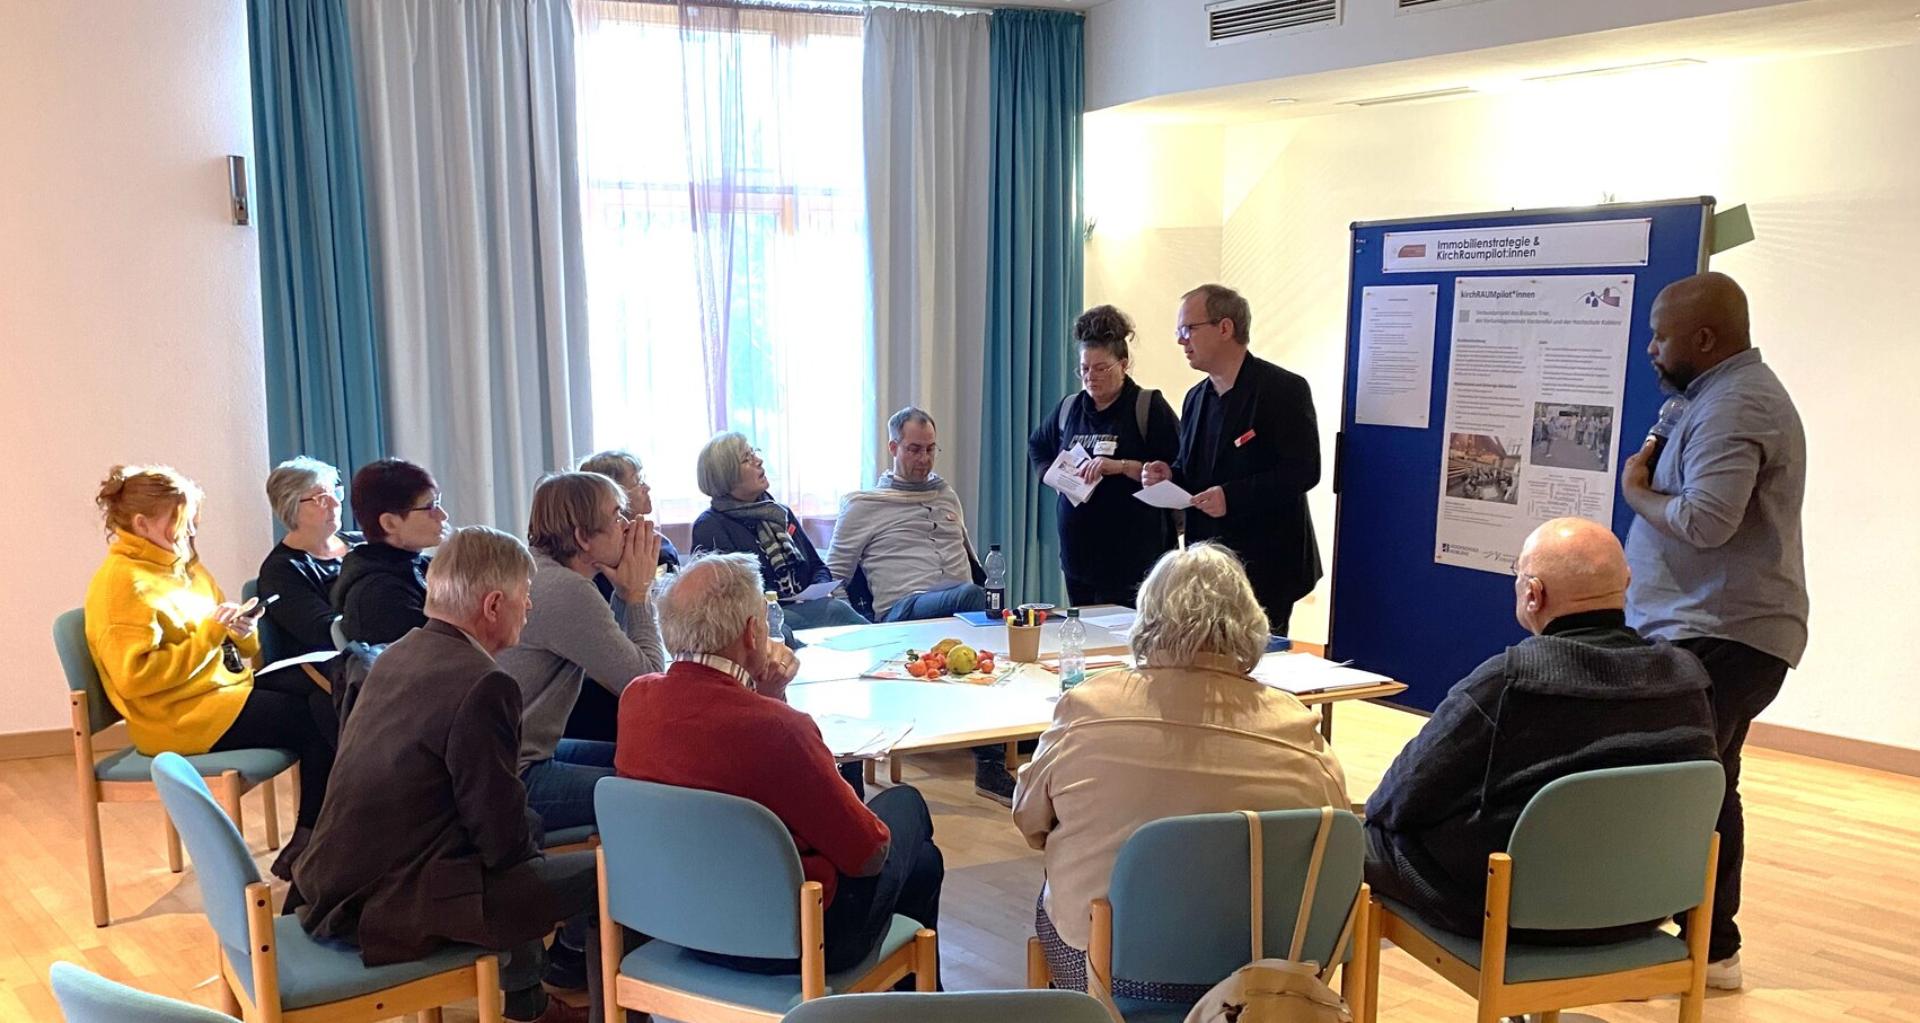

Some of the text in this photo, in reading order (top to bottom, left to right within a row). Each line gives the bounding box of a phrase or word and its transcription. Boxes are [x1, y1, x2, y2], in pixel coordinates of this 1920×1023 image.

[1437, 236, 1540, 250] Immobilienstrategie &
[1436, 248, 1536, 261] KirchRaumpilot:innen
